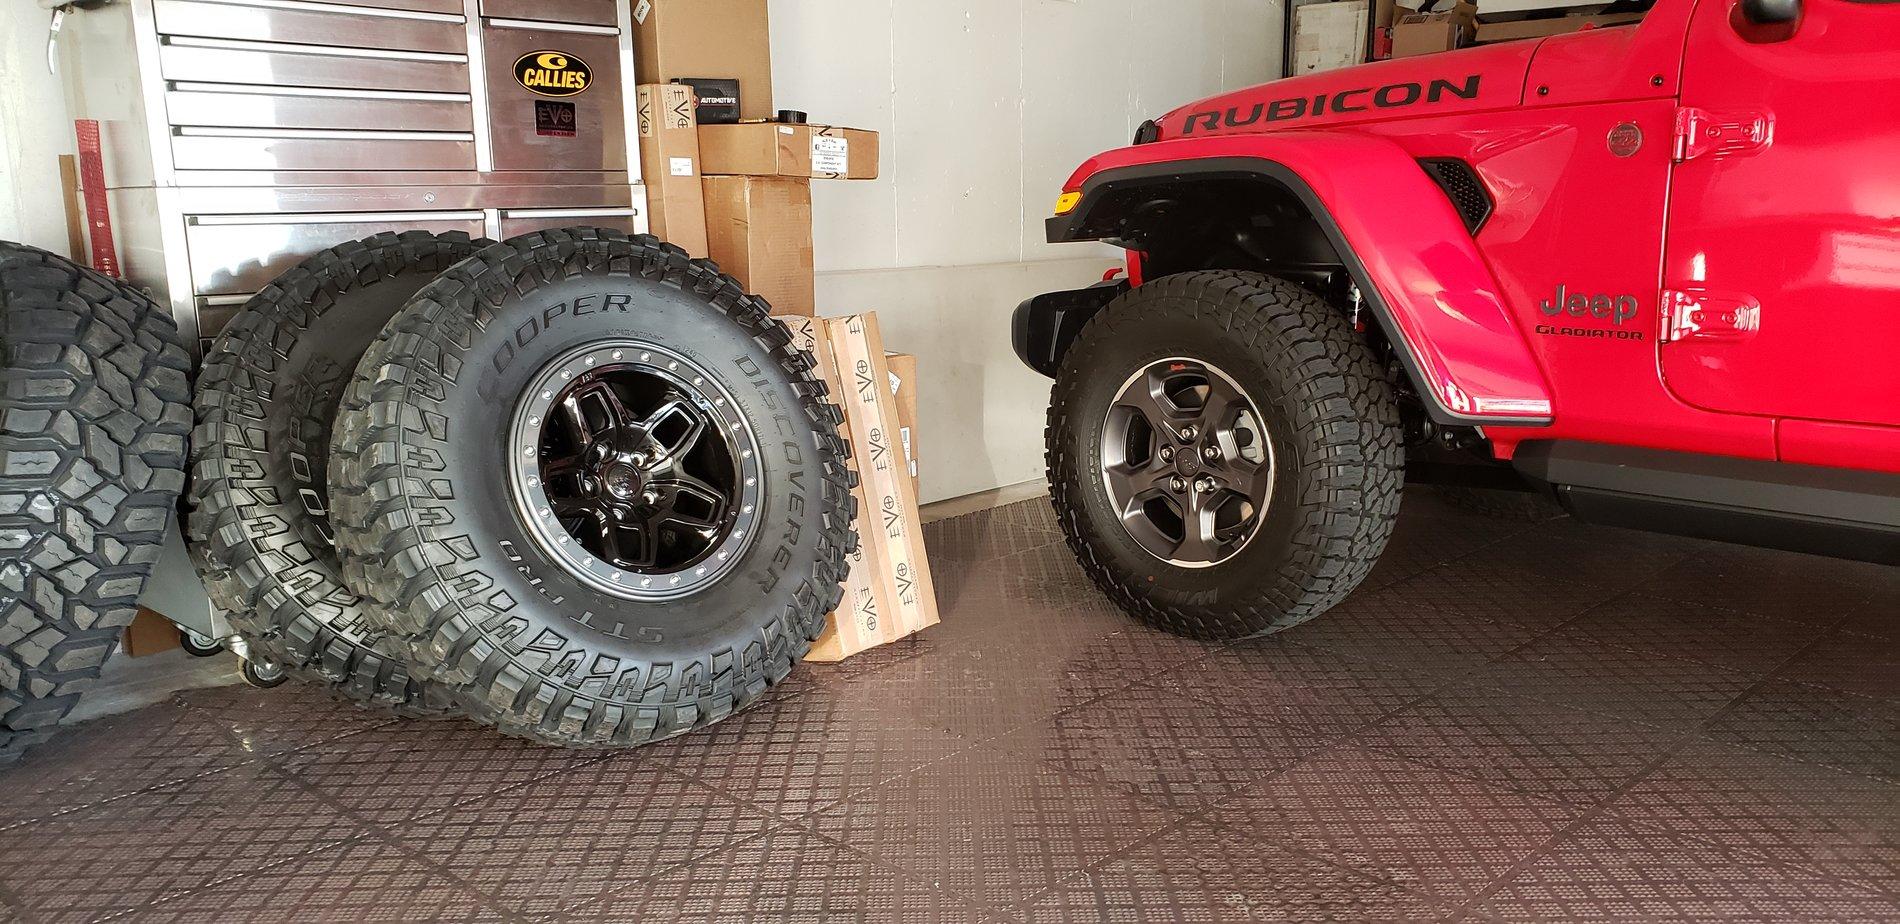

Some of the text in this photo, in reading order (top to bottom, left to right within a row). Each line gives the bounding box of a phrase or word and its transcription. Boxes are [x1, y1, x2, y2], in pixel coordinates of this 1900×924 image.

[524, 68, 586, 89] CALLIES
[1182, 75, 1481, 134] RUBICON
[1540, 283, 1638, 326] Jeep
[1535, 324, 1645, 342] GLADIATOR
[730, 353, 806, 597] DISCOVERER
[569, 611, 666, 644] STT
